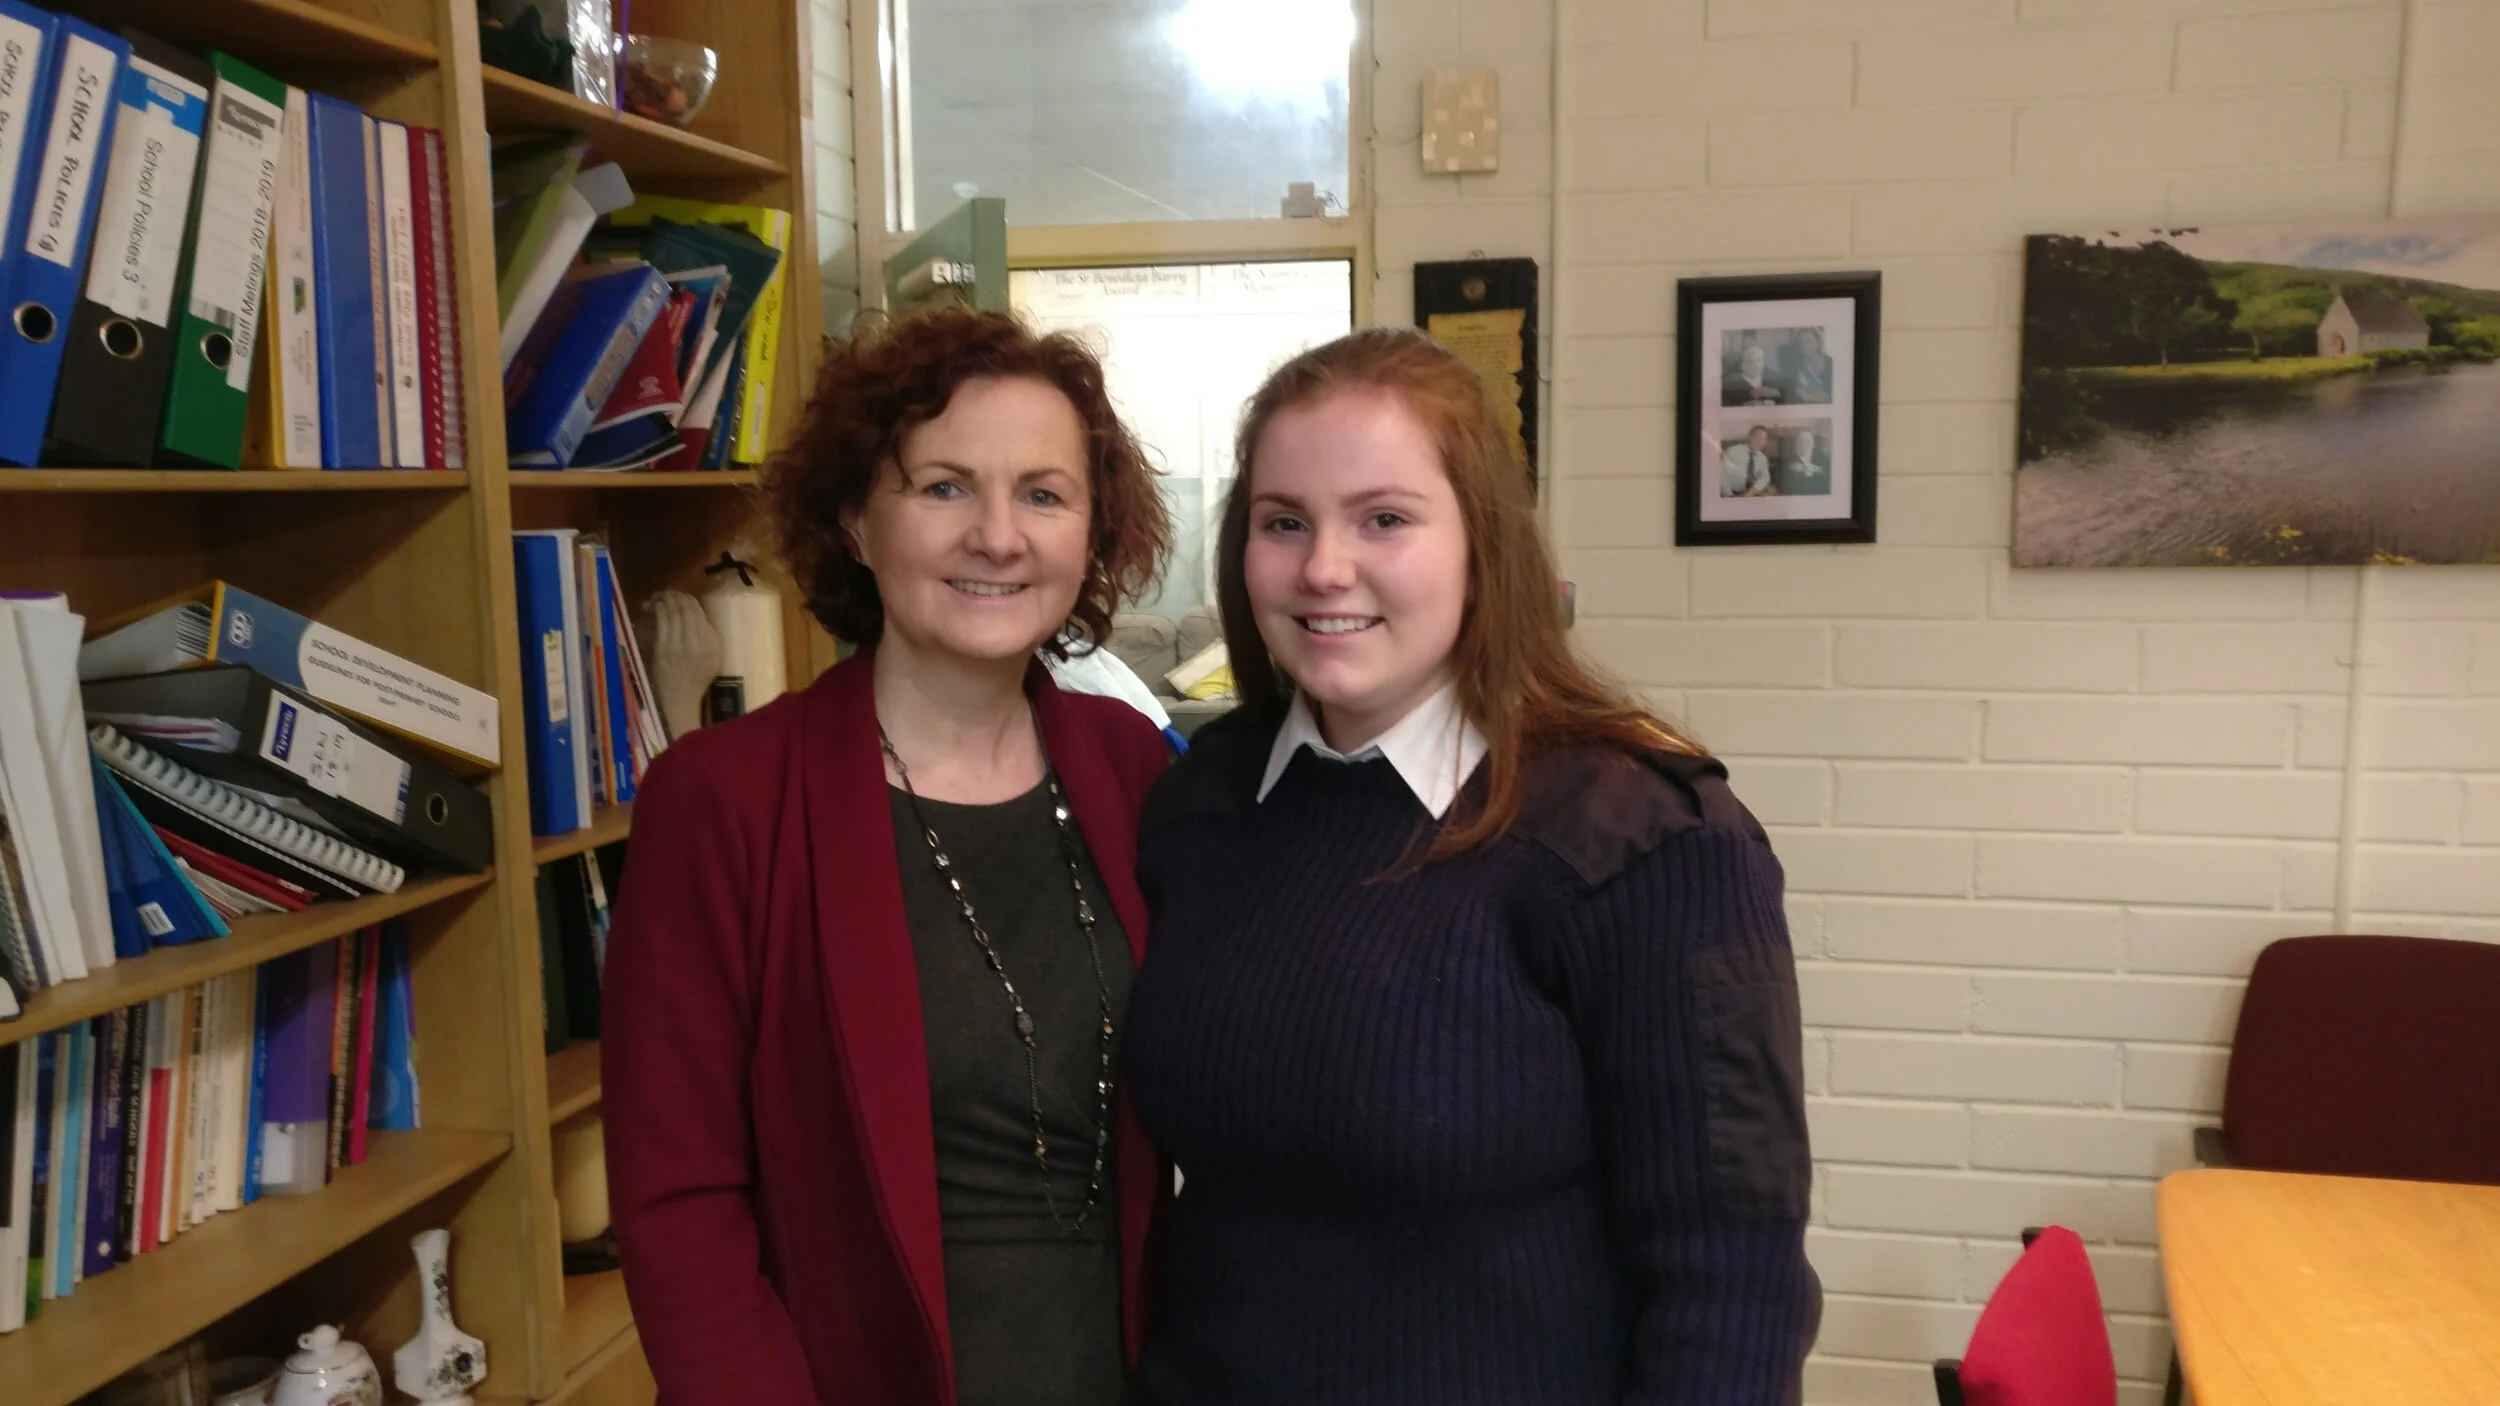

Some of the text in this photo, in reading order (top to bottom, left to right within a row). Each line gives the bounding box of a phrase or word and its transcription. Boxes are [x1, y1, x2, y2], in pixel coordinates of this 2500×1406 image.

[122, 137, 163, 285] School Policies 3
[235, 317, 252, 358] Staff
[311, 639, 350, 660] SCHOOL
[351, 655, 415, 686] DEVELOPMENT
